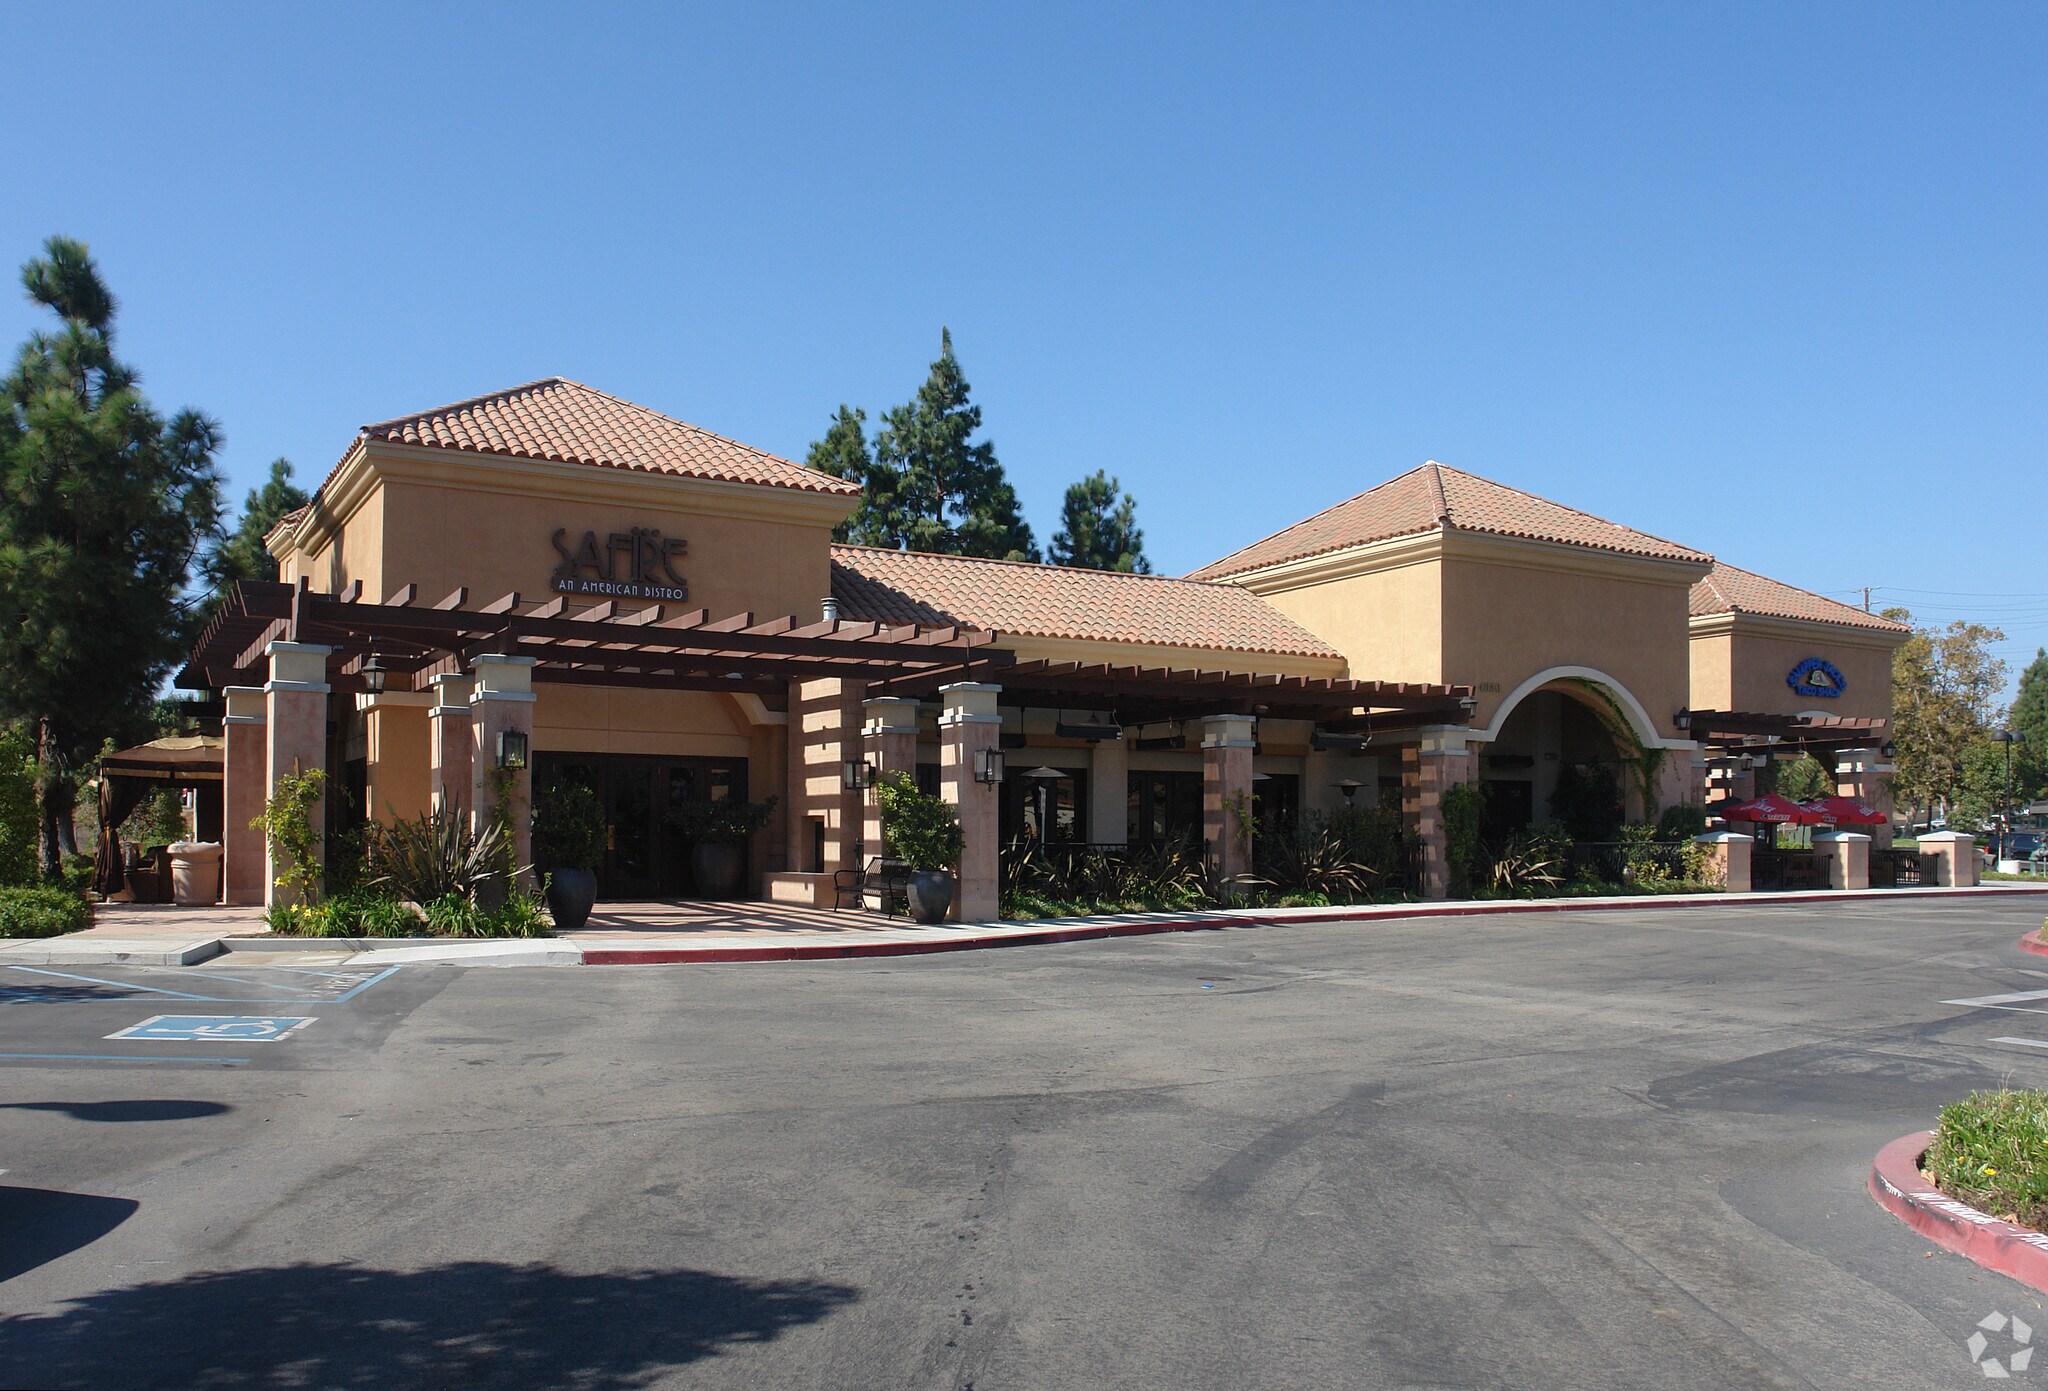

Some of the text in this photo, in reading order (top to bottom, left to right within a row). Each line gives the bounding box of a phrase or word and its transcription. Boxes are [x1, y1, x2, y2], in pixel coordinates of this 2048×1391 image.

[559, 579, 683, 600] AN AMERICAN BISTRO
[1797, 685, 1817, 697] TACO
